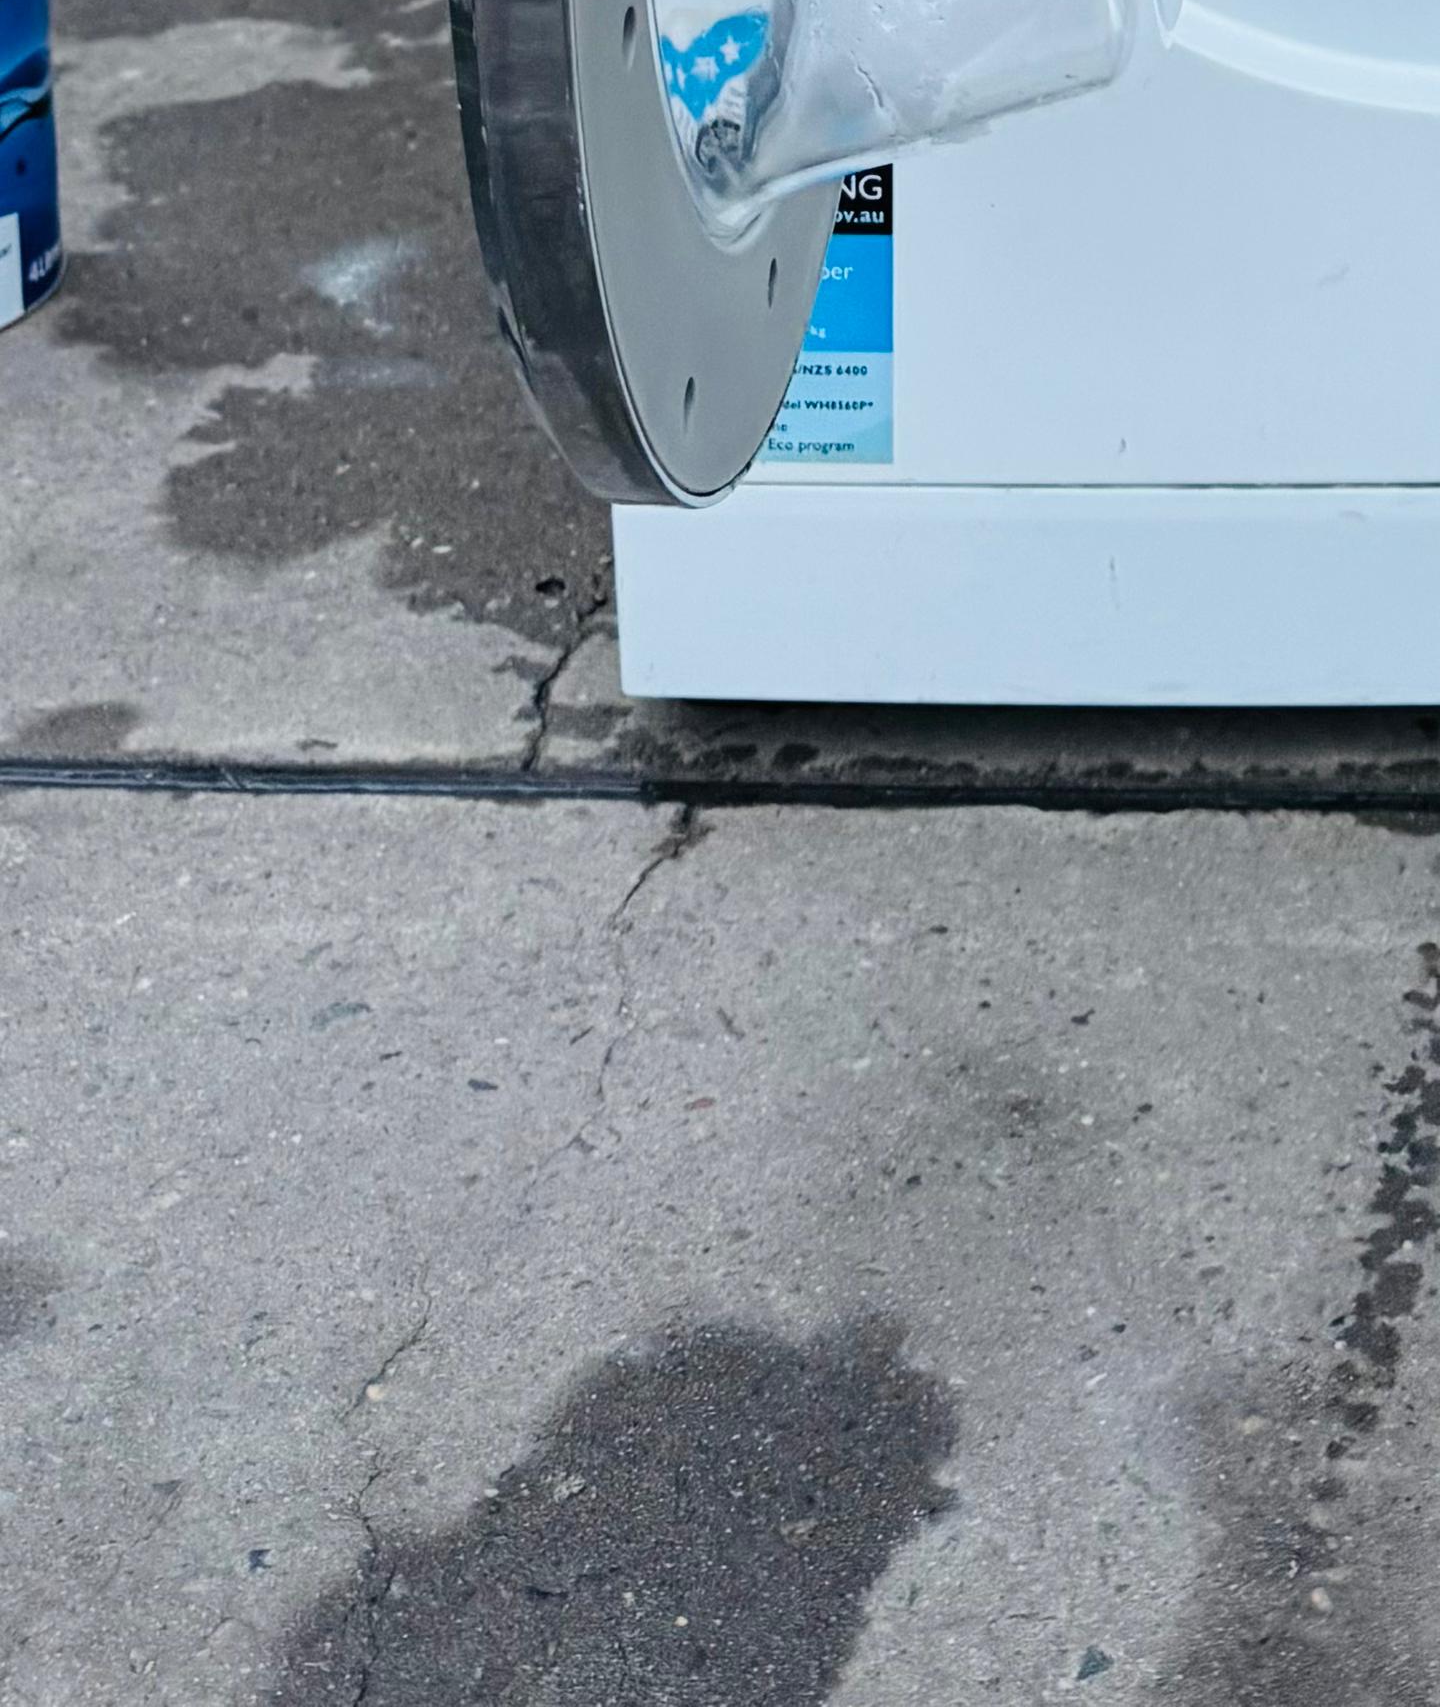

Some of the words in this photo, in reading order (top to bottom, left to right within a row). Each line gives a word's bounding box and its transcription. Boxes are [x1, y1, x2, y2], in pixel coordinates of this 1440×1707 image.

[837, 366, 867, 376] 6400
[768, 438, 794, 450] Eco
[799, 441, 855, 454] program
